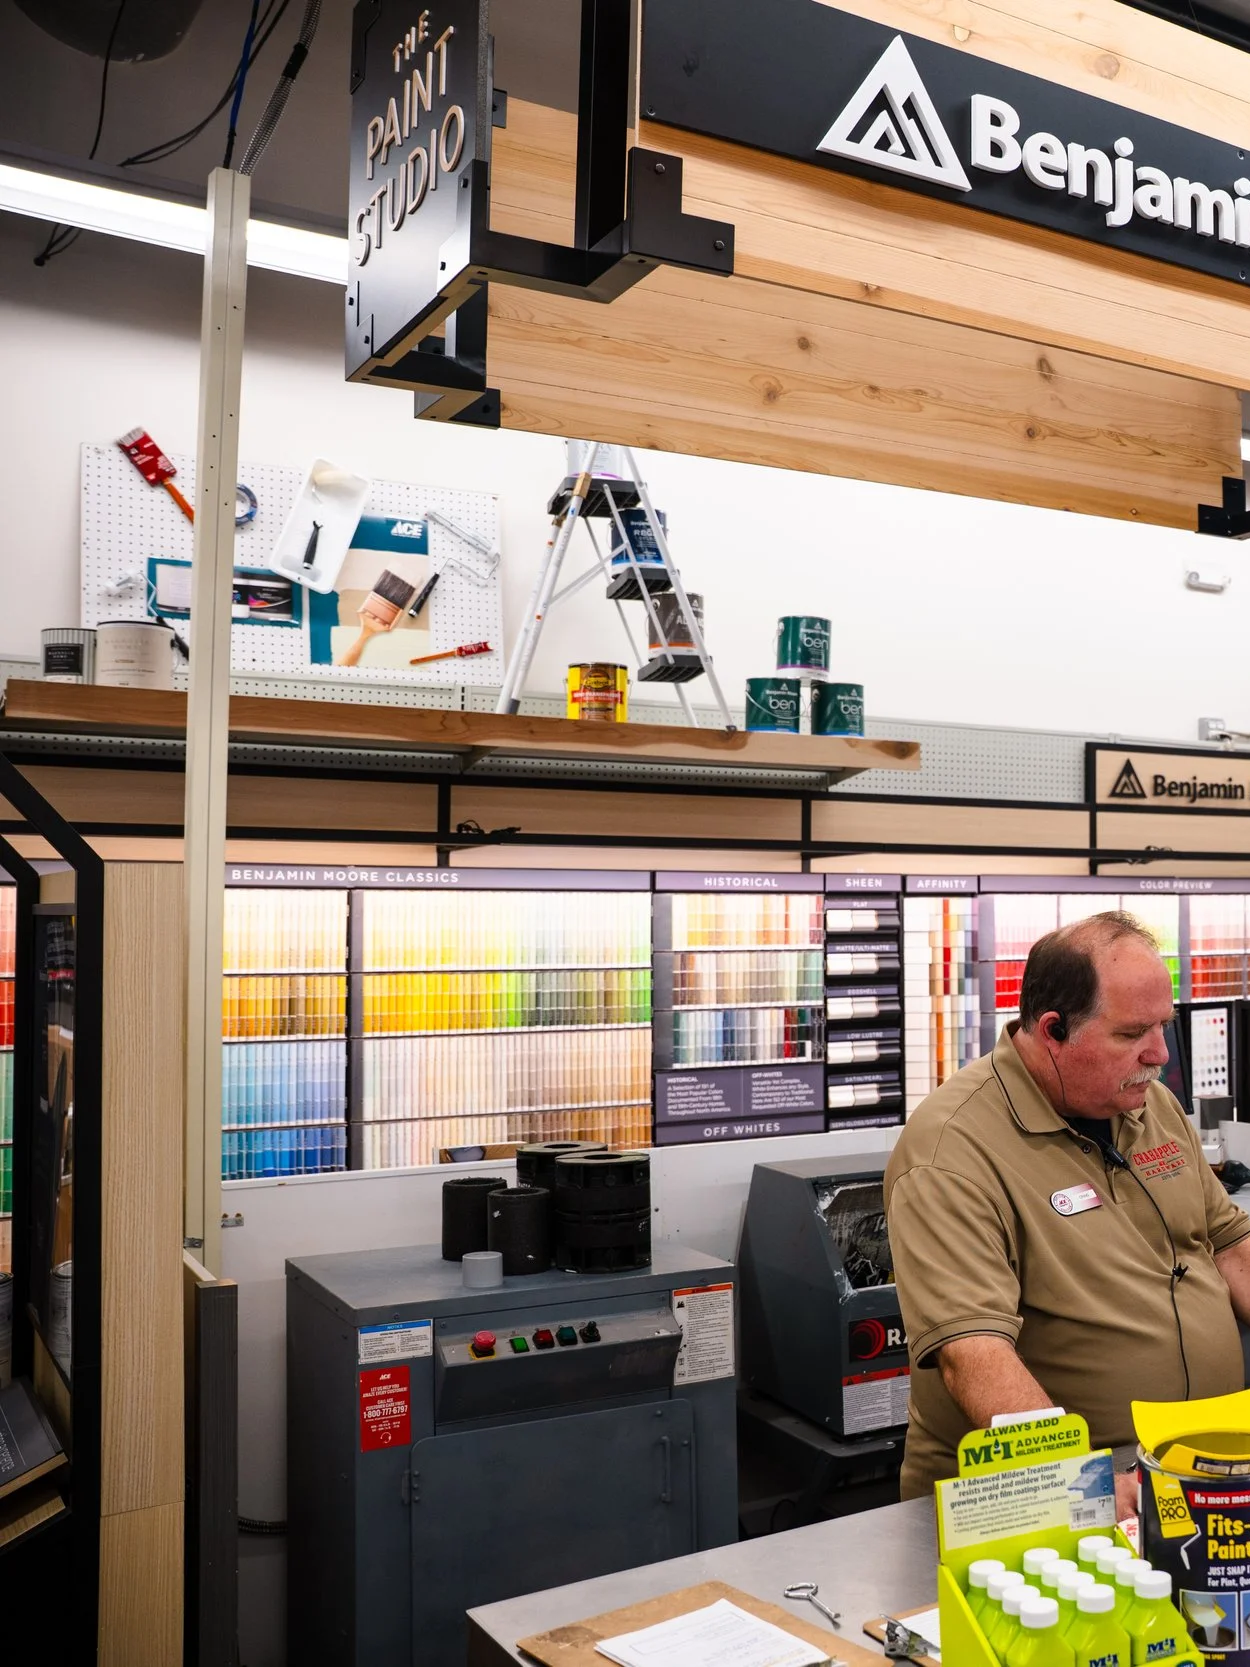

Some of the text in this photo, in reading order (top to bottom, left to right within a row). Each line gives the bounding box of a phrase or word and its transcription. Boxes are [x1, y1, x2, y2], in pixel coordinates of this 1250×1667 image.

[392, 9, 430, 73] THE
[366, 25, 454, 180] PAINT
[355, 104, 465, 267] STUDIO
[391, 520, 423, 539] ACE
[803, 634, 829, 649] ben
[769, 696, 796, 711] ben
[841, 701, 864, 715] ben
[1152, 774, 1245, 804] Benjamin
[231, 869, 460, 884] BENJAMIN MOORE CLASSICS
[704, 877, 778, 888] HISTORICAL
[845, 878, 883, 888] SHEEN
[917, 880, 967, 889] AFFINITY
[1140, 880, 1213, 890] COLOR PREVIEW
[703, 1123, 781, 1137] OFF WHITES
[1132, 1140, 1180, 1167] CRABAPPLE
[1145, 1159, 1185, 1177] HARDWARE
[363, 1405, 408, 1419] 1-800-777-6797
[984, 1417, 1060, 1438] ALWAYS ADD
[1016, 1429, 1081, 1448] ADVANCED
[1015, 1439, 1081, 1457] MILDEW TREATMENT
[953, 1463, 1061, 1489] M-1 Advanced Mildew Treatment
[959, 1473, 1057, 1497] resists mold and mildew from
[950, 1497, 978, 1509] growing
[988, 1491, 999, 1501] dry
[1000, 1487, 1013, 1497] film
[1014, 1483, 1040, 1496] coatings
[1041, 1479, 1066, 1490] surface!
[1158, 1496, 1185, 1507] Foam
[1194, 1493, 1206, 1504] No
[1207, 1494, 1230, 1505] more
[1161, 1506, 1187, 1520] PRO
[1208, 1566, 1226, 1576] JUST
[1227, 1565, 1246, 1576] SNAP
[1208, 1577, 1219, 1587] For
